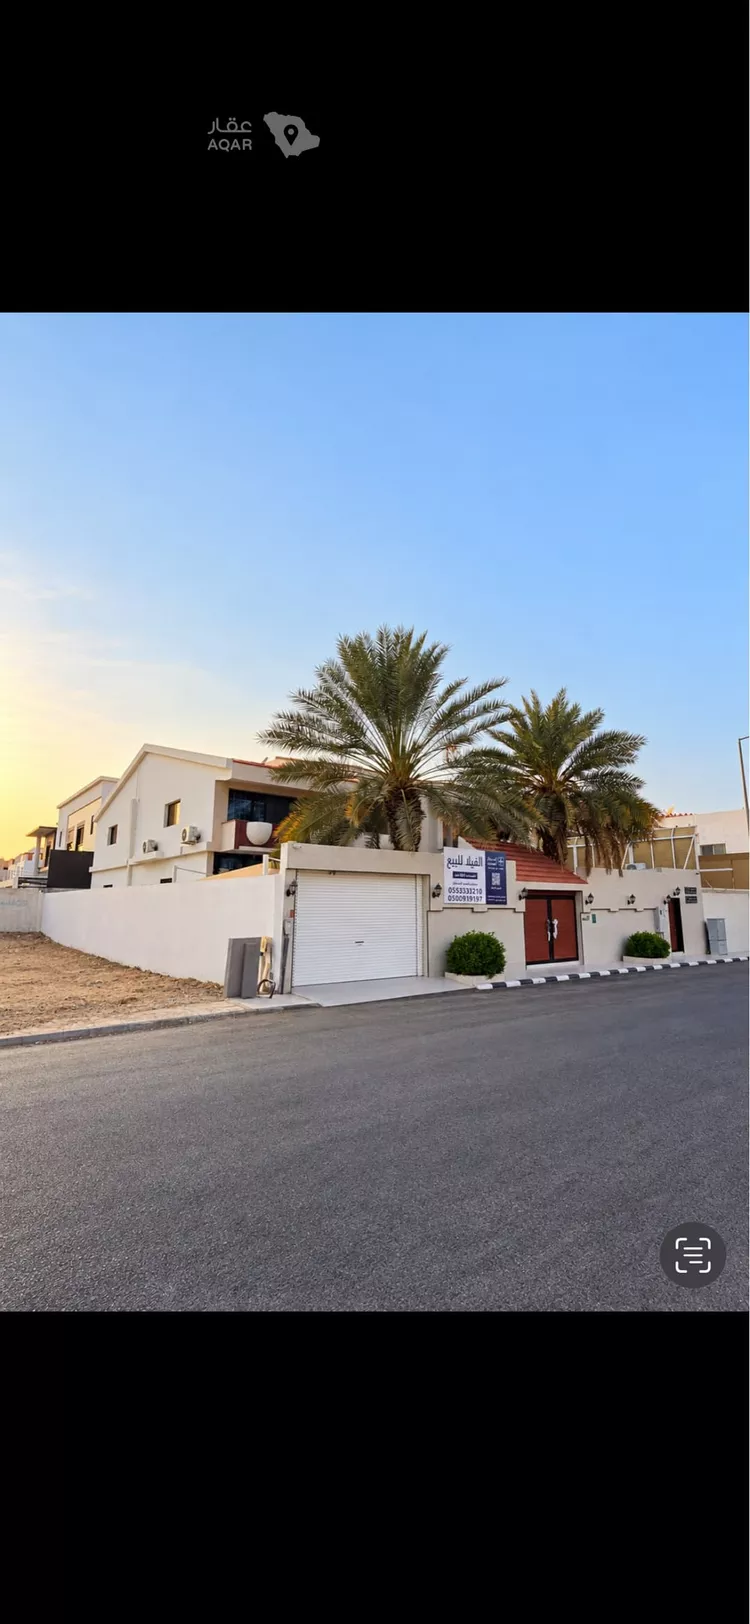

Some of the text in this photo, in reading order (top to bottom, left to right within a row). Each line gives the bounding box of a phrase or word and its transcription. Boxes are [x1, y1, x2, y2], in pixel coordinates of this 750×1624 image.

[447, 855, 463, 869] للبيع
[466, 856, 483, 869] الفيلا
[448, 887, 483, 895] 0553333210
